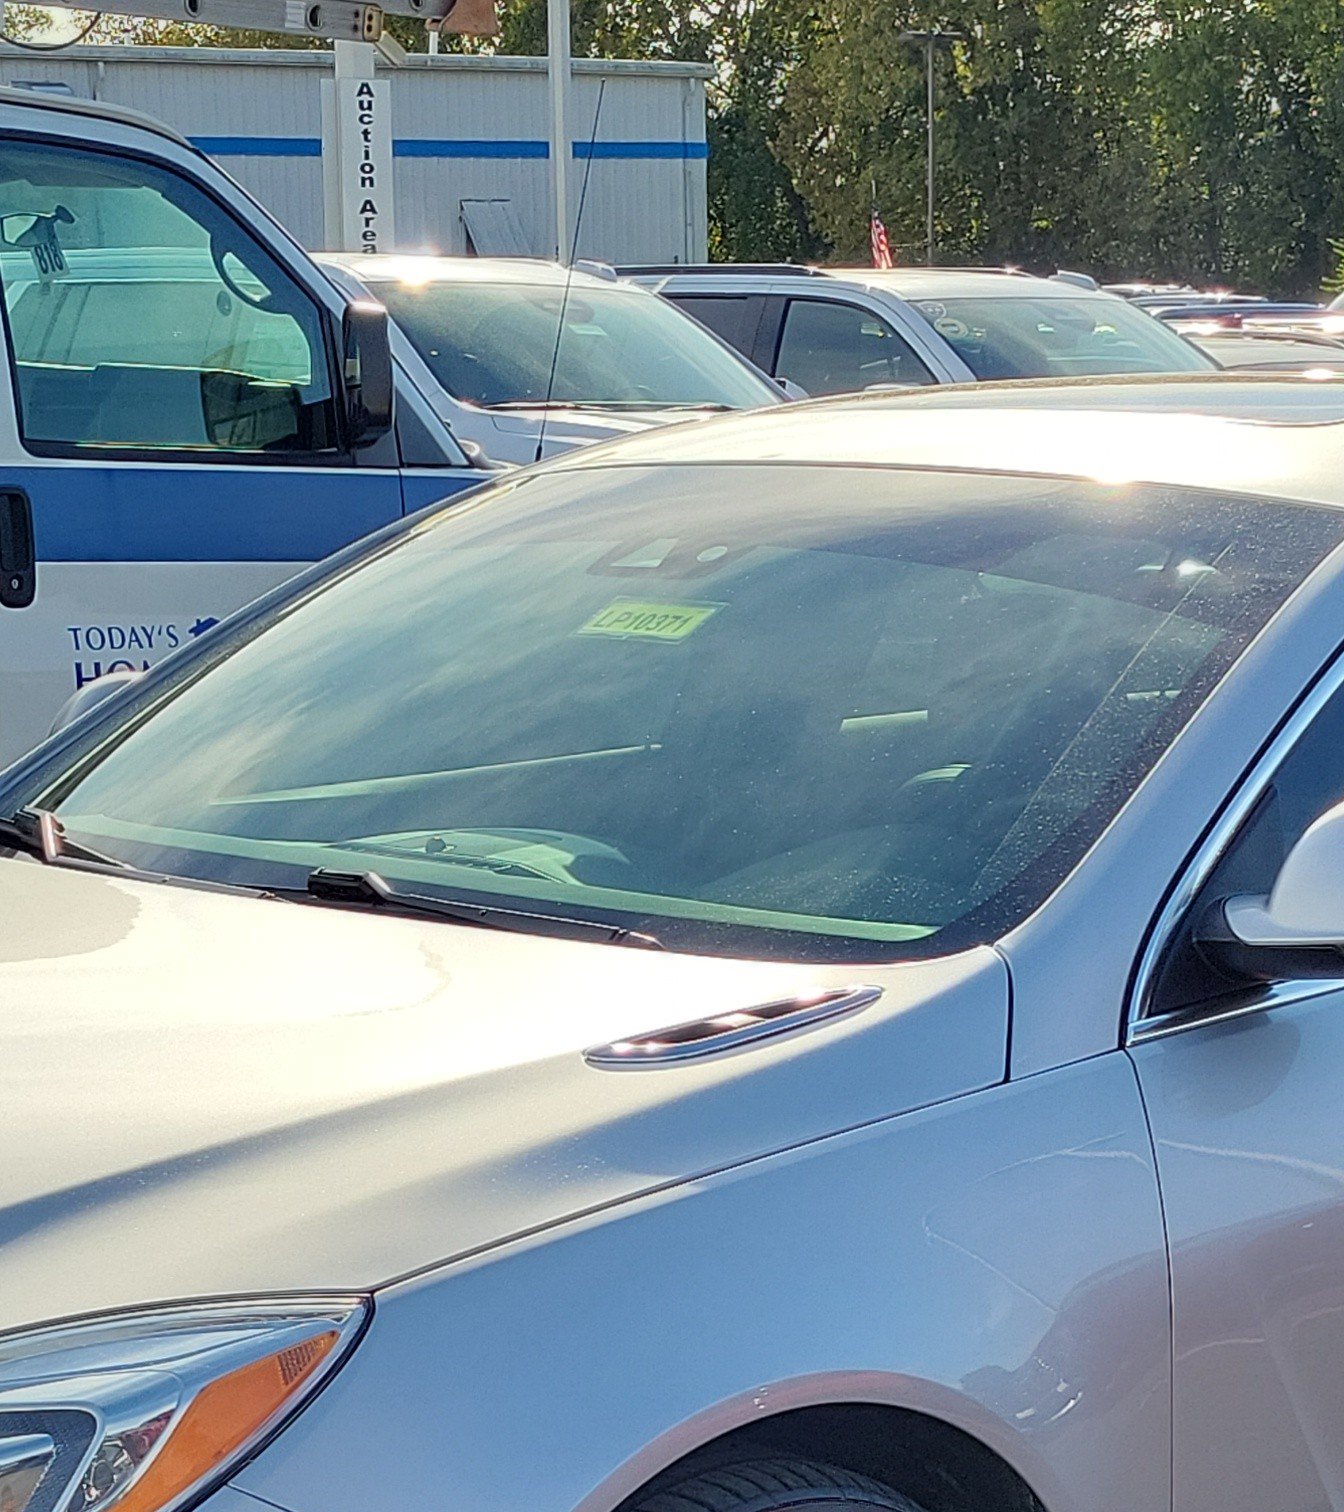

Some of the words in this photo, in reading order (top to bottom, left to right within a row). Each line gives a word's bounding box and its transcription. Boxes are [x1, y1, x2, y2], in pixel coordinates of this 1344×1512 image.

[356, 81, 375, 188] Auction
[359, 199, 378, 254] Area
[67, 624, 179, 651] TODAY'S
[592, 610, 694, 634] LP10371
